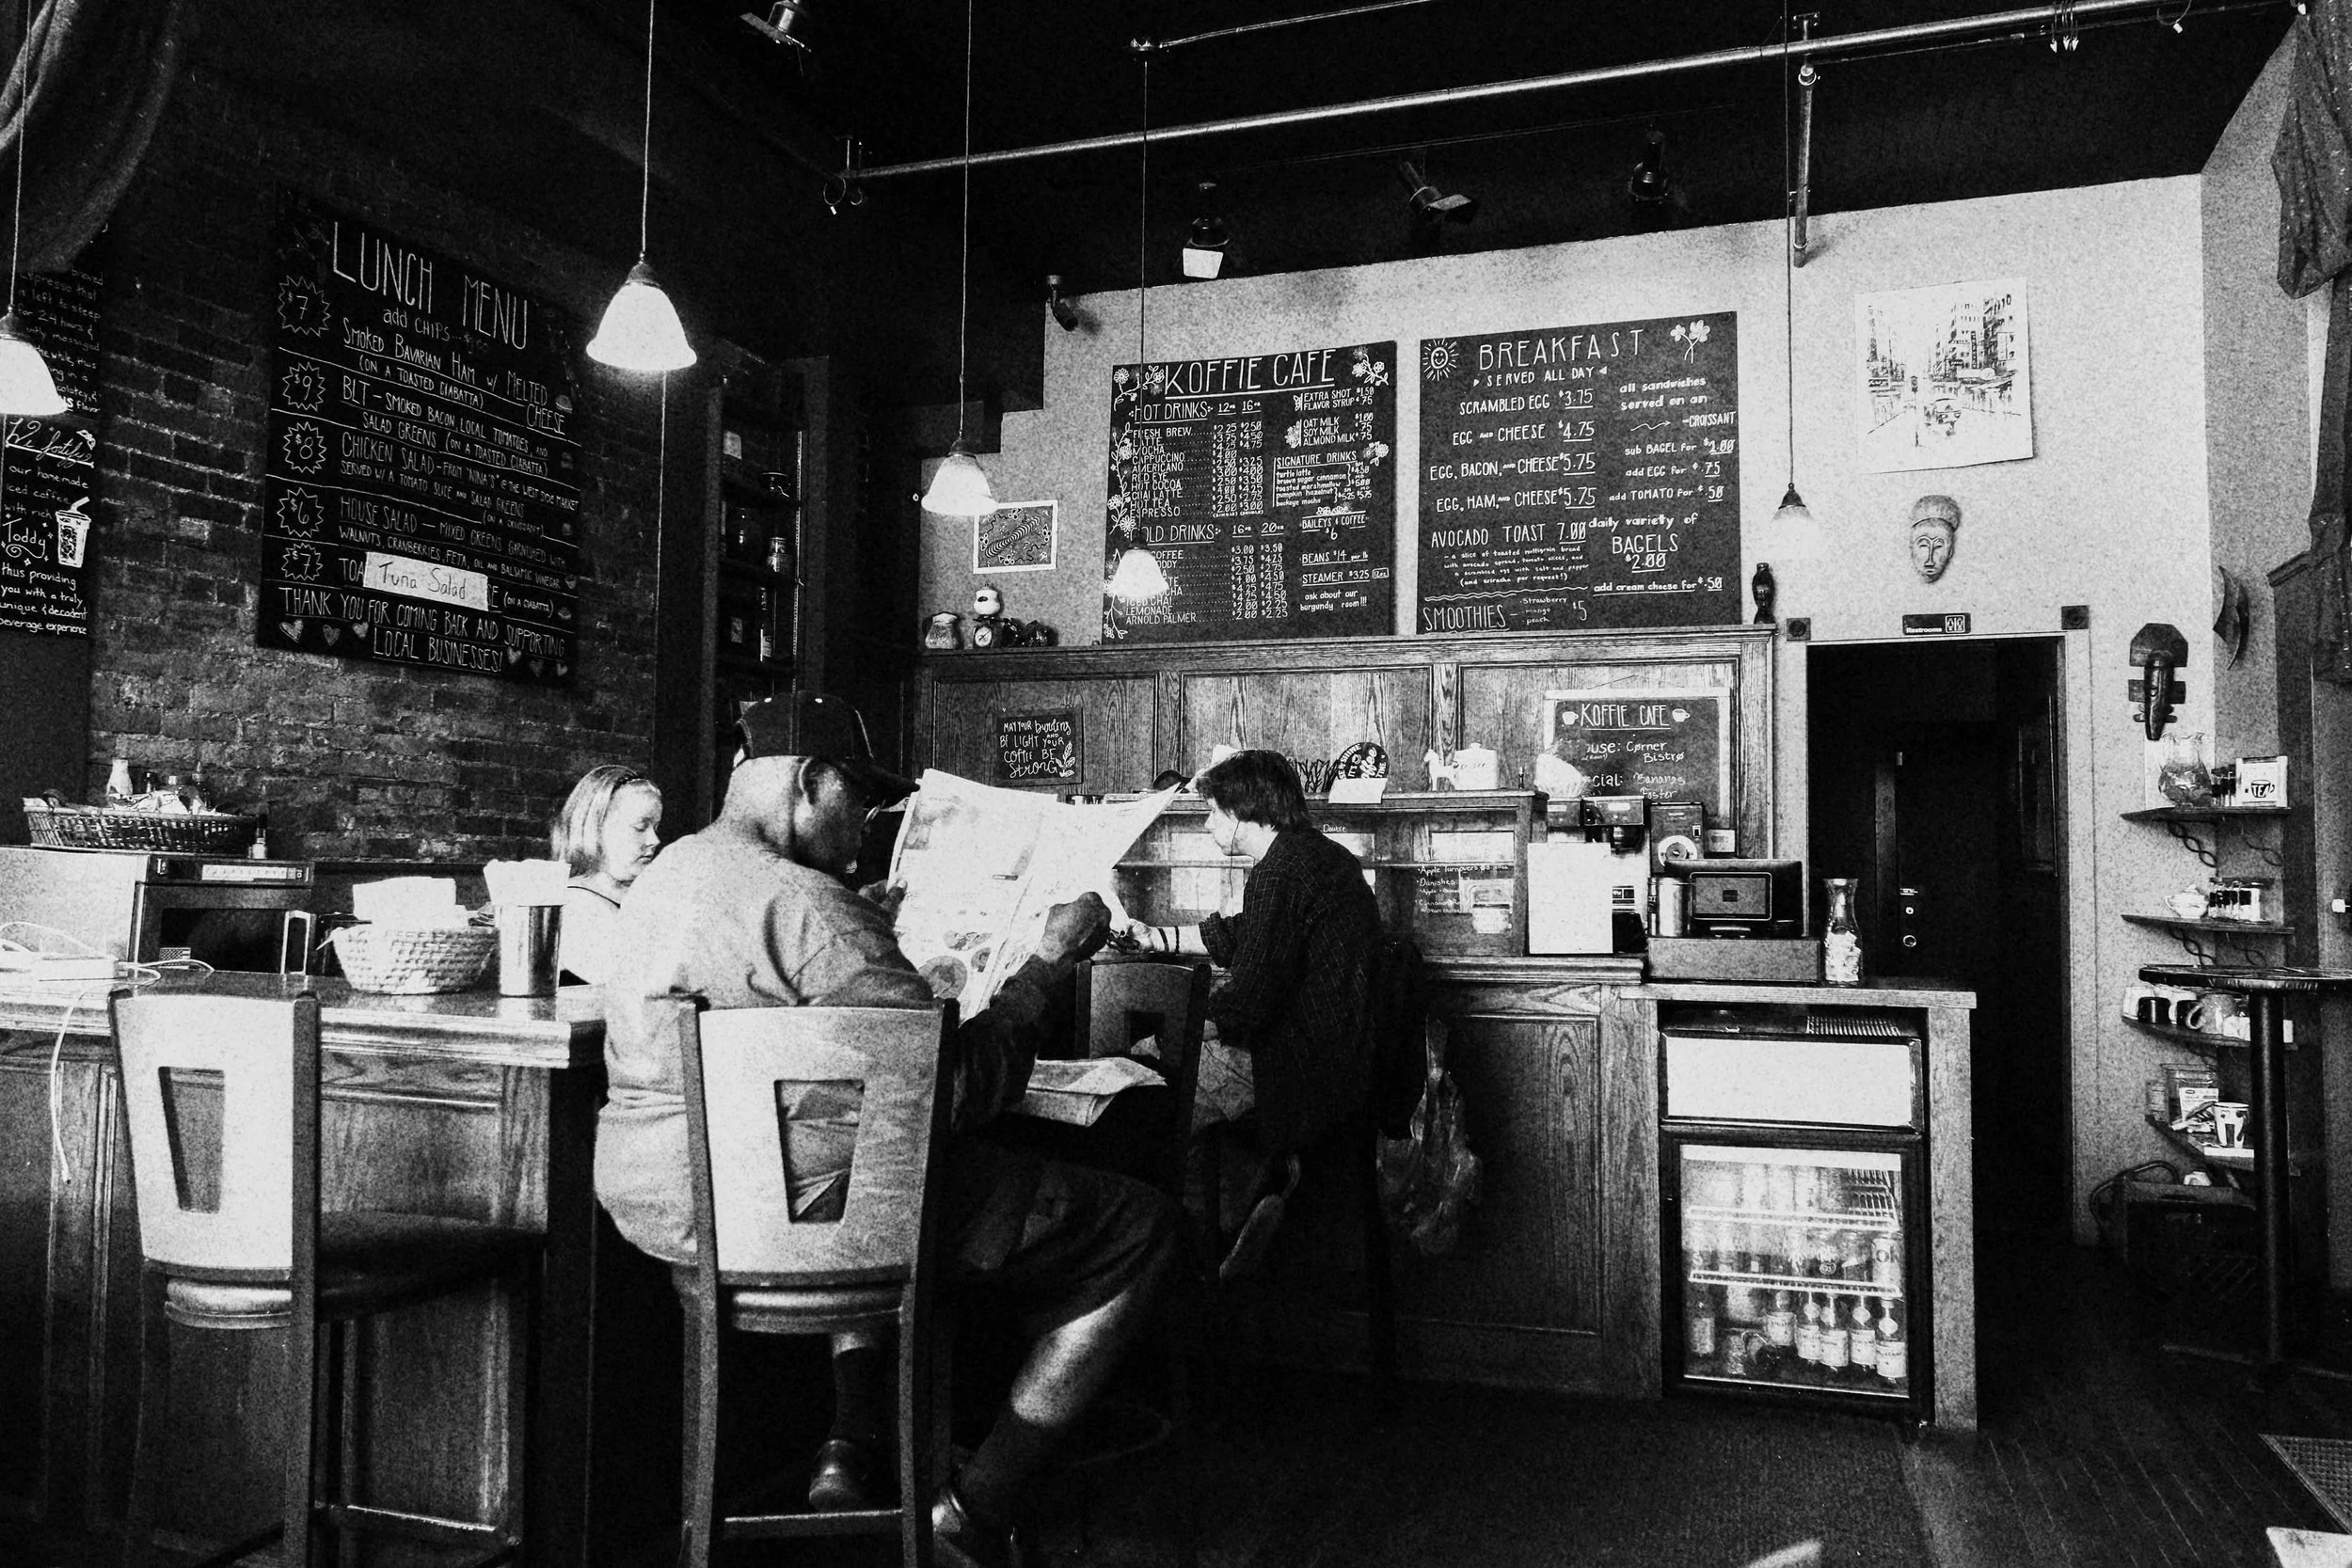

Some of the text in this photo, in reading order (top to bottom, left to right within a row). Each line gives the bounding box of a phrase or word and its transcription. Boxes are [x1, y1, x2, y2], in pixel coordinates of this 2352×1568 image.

[333, 221, 528, 350] LUNCH MENU
[383, 308, 451, 341] add CHIPS
[1480, 329, 1644, 371] BREAKFAST
[343, 317, 385, 353] SMOKED
[395, 333, 441, 371] BAVARIAN
[452, 351, 475, 385] HAM
[507, 370, 548, 406] MELTED
[396, 367, 435, 391] TOASTED
[1164, 348, 1337, 396] KOFFIE CAFE
[1486, 365, 1595, 388] SERVED ALL DAY
[1619, 376, 1708, 393] all sandwiches
[1303, 388, 1352, 403] EXTRA SHOT
[1303, 396, 1355, 411] FLAVOR SYRUP
[1620, 394, 1708, 411] served on an
[342, 374, 486, 440] BLT SMOKED LOCAL
[1134, 400, 1208, 421] HOT DRINKS
[1459, 393, 1550, 416] SCRAMBLED EGG
[526, 403, 565, 436] CHEESE
[1303, 416, 1341, 429] OAT MILK
[362, 411, 507, 467] SALAD GREENS TOASTED
[1166, 426, 1193, 437] BREW
[1302, 432, 1356, 447] ALMOND MILK
[1303, 424, 1340, 438] SOY MILK
[1452, 423, 1546, 446] EGG CHEESE
[294, 433, 314, 460] $8
[342, 431, 435, 475] CHICKEN SALAD
[1624, 441, 1697, 456] sub BAGEL for
[1276, 451, 1358, 467] SIGNATURE DRINKS
[8, 465, 33, 475] our
[341, 459, 428, 492] SERVED TOMATO
[1429, 455, 1559, 481] EGG, BACON, CHEESE
[1625, 465, 1687, 477] add EGG for
[1276, 477, 1296, 485] brown
[1305, 486, 1334, 497] hazelnut
[1609, 487, 1693, 501] add TOMATO for
[1152, 498, 1171, 508] TEA
[1276, 498, 1299, 508] buckeye
[1436, 489, 1557, 513] EGG, HAM, CHEESE
[290, 498, 310, 525] $6
[1129, 506, 1182, 519] ESPRESSO
[340, 496, 502, 552] HOUSE SALAD MIXED GREENS
[1302, 514, 1366, 530] BAILEYS COFFEE
[1588, 512, 1699, 533] daily variety of
[2, 517, 47, 559] Toddy
[1169, 523, 1215, 542] DRINKS
[1431, 521, 1587, 548] AVOCADO TOAST 7.00
[1612, 532, 1678, 554] BAGELS
[1301, 551, 1330, 564] BEANS
[1, 562, 76, 592] thus providing
[378, 561, 418, 589] Tuna
[427, 566, 467, 600] Salad
[1302, 571, 1343, 584] STEAMER
[1593, 579, 1697, 592] add cream cheese for
[1, 584, 21, 597] you
[25, 586, 47, 599] with
[1304, 589, 1359, 601] ask about our
[0, 601, 38, 615] unique
[1125, 605, 1173, 616] LEMONADE
[1299, 600, 1334, 612] burgundy
[278, 586, 565, 657] THANK YOU FOR COMING BACK AND SUPPORTING
[1125, 611, 1198, 626] ARNOLD PALMER
[1422, 599, 1588, 632] SMOOTHIES $5
[1526, 616, 1550, 626] peach
[373, 626, 503, 673] LOCAL BUSINESSES!
[1580, 703, 1670, 727] KOFFIE CAFE
[1003, 721, 1017, 733] MAY
[1017, 720, 1032, 732] YOUR
[999, 734, 1009, 748] BE
[1013, 734, 1039, 748] LIGHT
[1042, 736, 1065, 749] YOUR
[1041, 748, 1057, 760] BE
[2251, 784, 2271, 798] TEA
